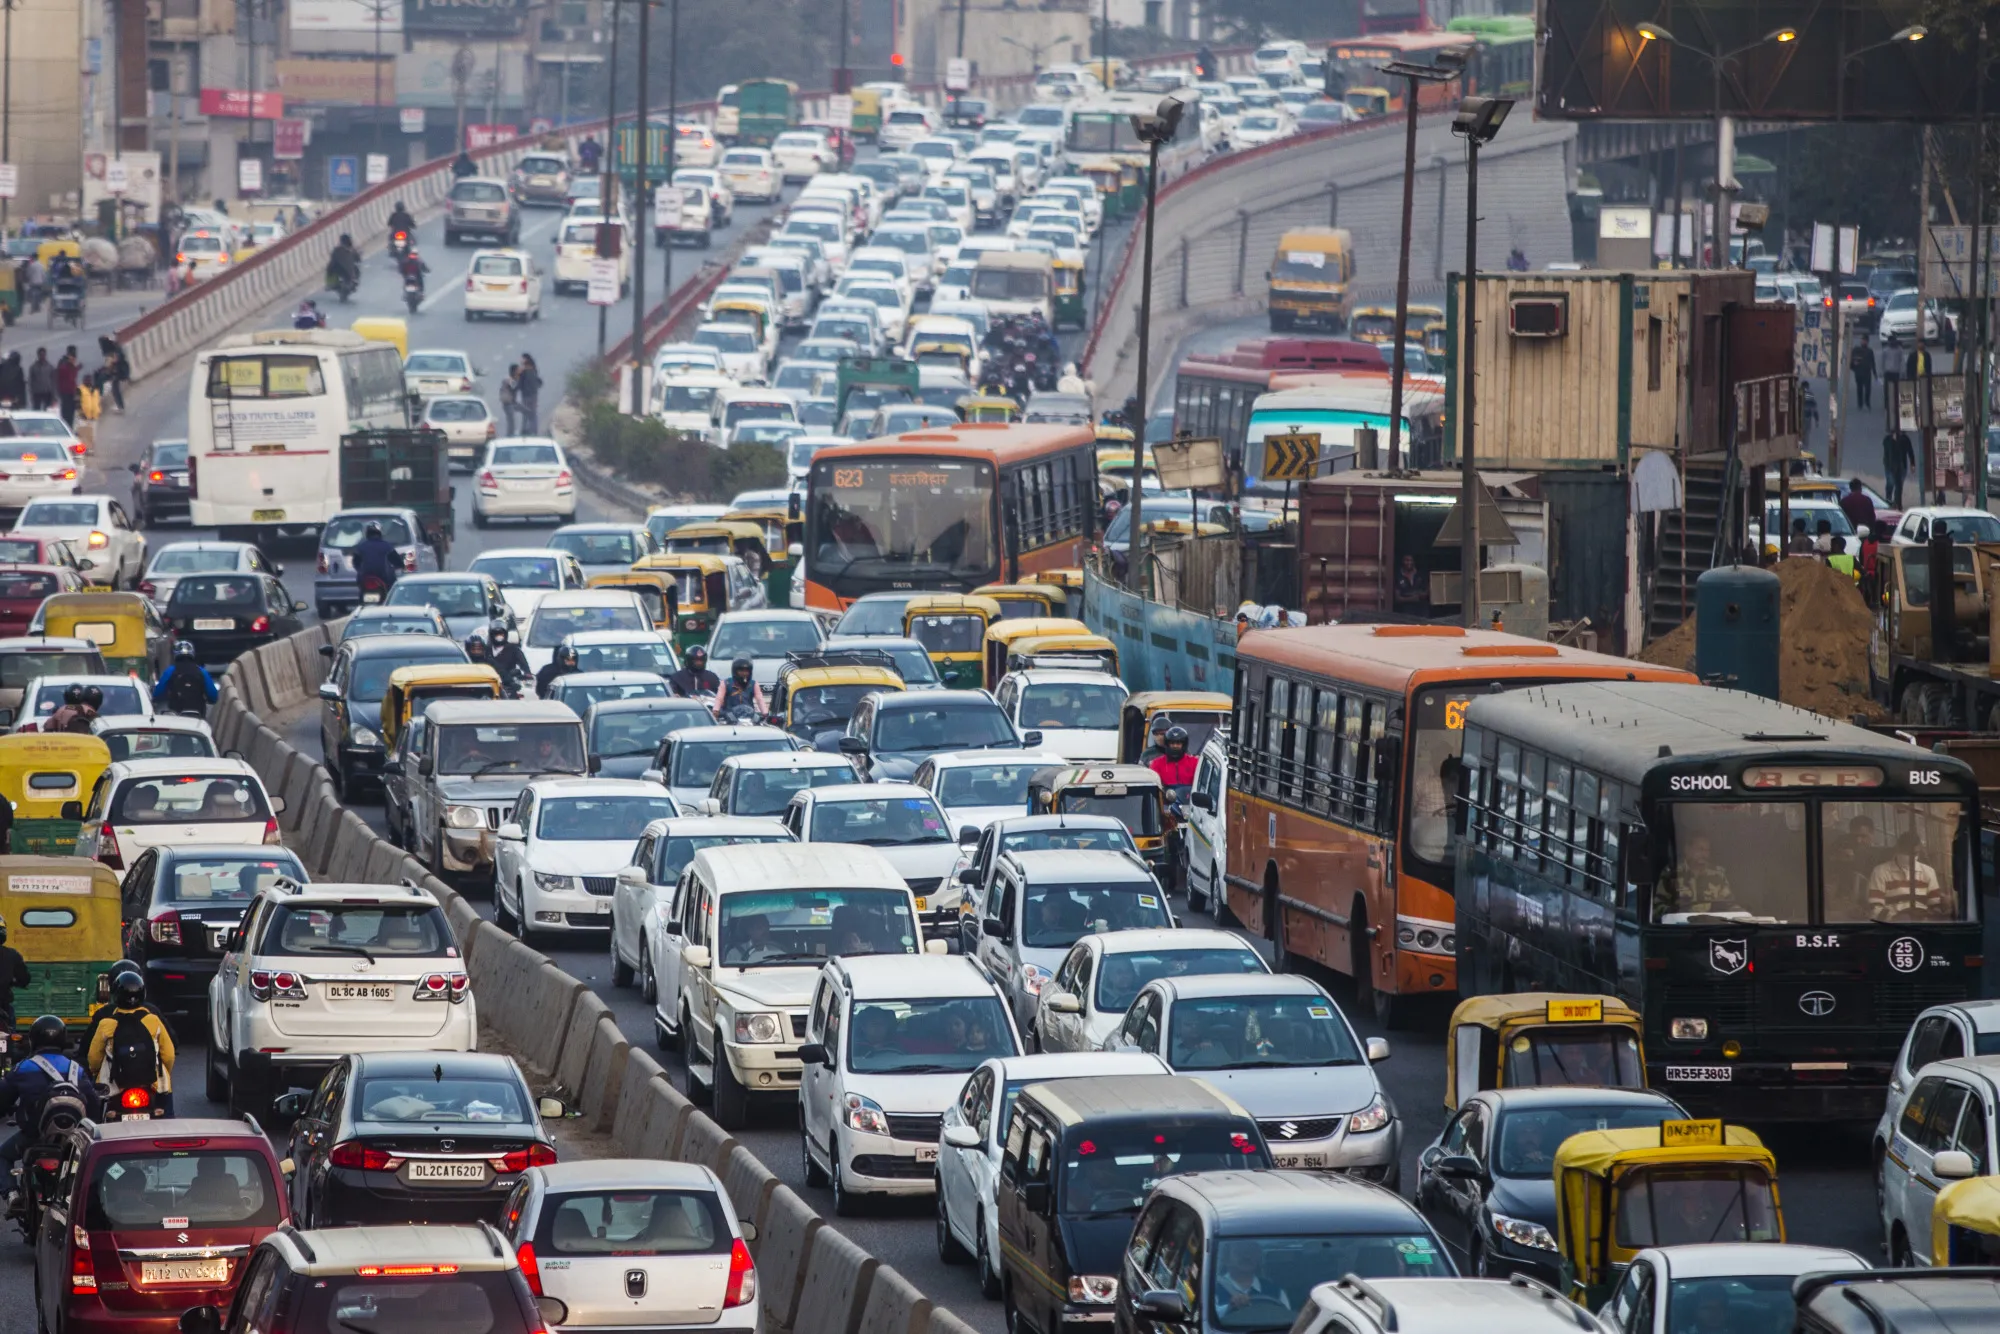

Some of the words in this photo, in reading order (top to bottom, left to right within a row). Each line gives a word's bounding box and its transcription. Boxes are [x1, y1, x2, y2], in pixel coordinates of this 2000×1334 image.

[835, 469, 863, 487] 623
[1670, 775, 1732, 790] SCHOOL
[1909, 770, 1941, 785] BUS
[1796, 935, 1840, 948] B.S.F.
[1896, 941, 1913, 953] 25
[1896, 957, 1913, 968] 59
[331, 987, 341, 996] DL
[344, 988, 354, 996] 8C
[357, 988, 368, 997] AB
[371, 988, 390, 998] 1605
[1563, 1006, 1574, 1017] ON
[1575, 1006, 1592, 1017] DUTY
[1667, 1069, 1731, 1080] HR55F3803
[1304, 1157, 1322, 1167] 1614
[416, 1165, 483, 1177] DL2CAT6207
